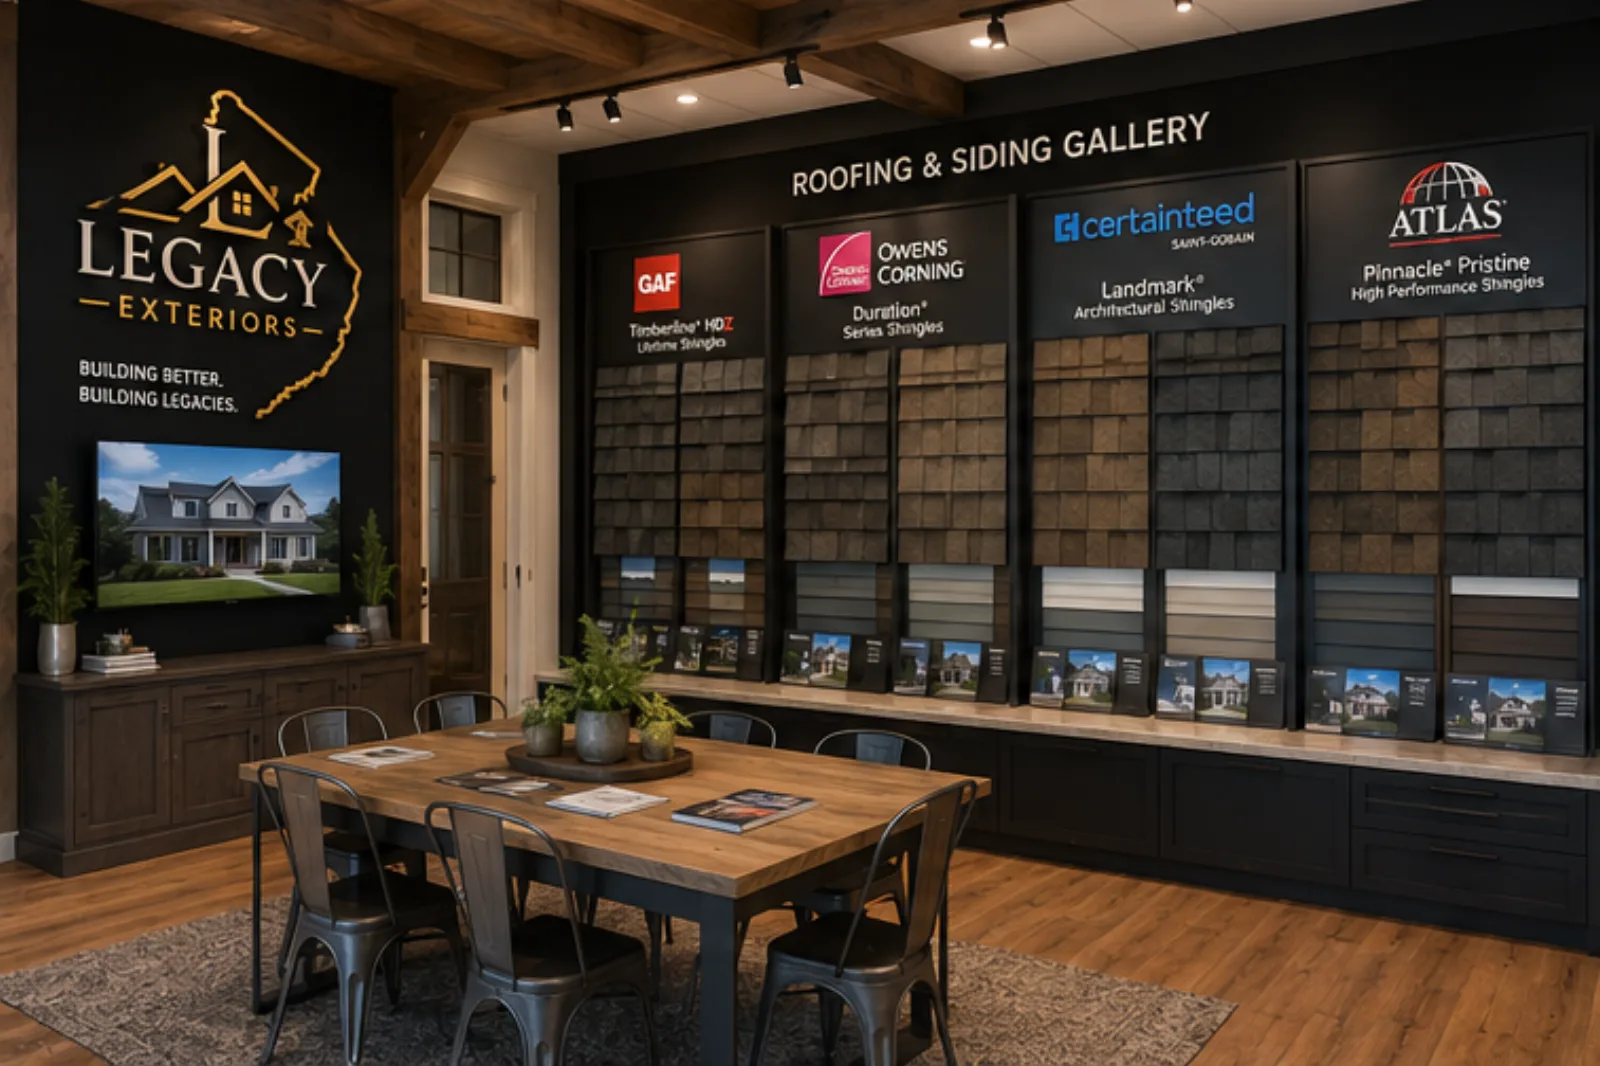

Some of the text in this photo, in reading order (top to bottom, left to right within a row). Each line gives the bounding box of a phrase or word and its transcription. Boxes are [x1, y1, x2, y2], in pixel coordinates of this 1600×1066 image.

[792, 111, 1210, 197] ROOFING & SIDING GALLERY
[1082, 191, 1255, 239] certainteed
[1388, 200, 1502, 238] ATLAS
[77, 219, 328, 308] LEGACY
[877, 238, 948, 262] OWENS
[1458, 252, 1531, 275] Pristine
[638, 271, 677, 295] GAF
[877, 260, 965, 285] CORNING
[1352, 274, 1545, 303] High Performance Shingles
[119, 295, 297, 338] EXTERIORS
[1074, 296, 1235, 320] Architectural Shingles
[842, 320, 944, 340] Series Shingles
[79, 359, 224, 388] BUILDING BETTER.
[79, 385, 239, 413] BUILDING LEGACIES.
